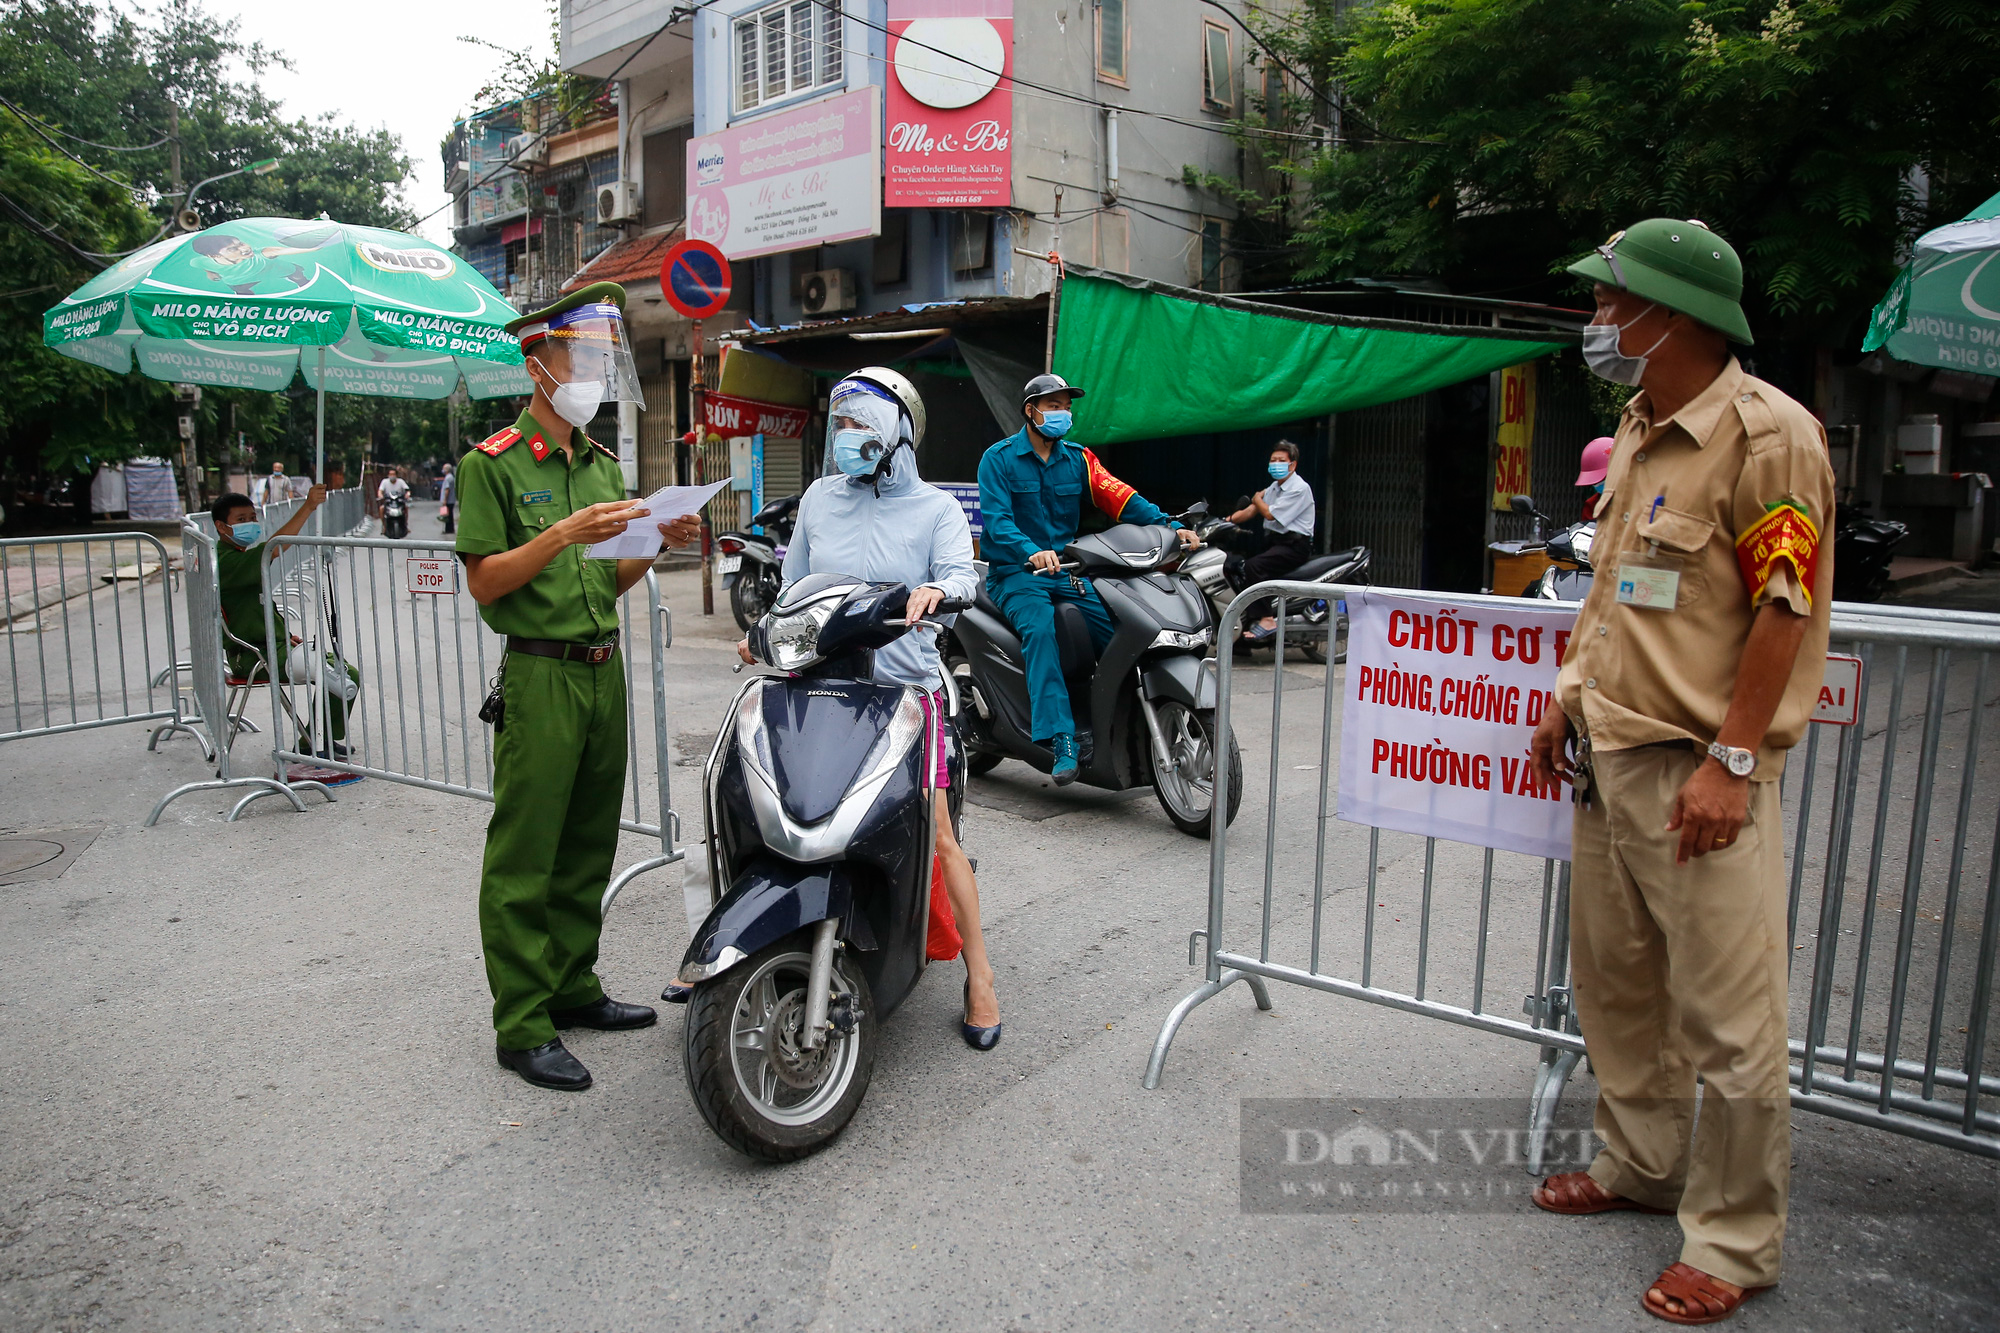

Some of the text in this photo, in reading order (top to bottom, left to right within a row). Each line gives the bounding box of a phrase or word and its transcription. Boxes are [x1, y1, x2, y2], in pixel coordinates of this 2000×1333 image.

[889, 120, 1010, 156] Mẹ & Bé
[697, 154, 724, 172] Merries
[891, 164, 1004, 176] Chuyên Order Hàng Xách Tay
[750, 171, 830, 210] Mẹ & Bé
[936, 195, 954, 204] 0944
[368, 247, 446, 270] MILO
[152, 302, 332, 324] MILO NĂNG LƯỢNG
[193, 328, 210, 336] NHÀ
[213, 320, 290, 340] VÔ ĐỊCH
[374, 310, 520, 346] MILO NĂNG LƯỢNG
[408, 330, 424, 338] CHO
[425, 333, 488, 354] VÔ ĐỊCH
[705, 401, 740, 430] BÚN
[1752, 538, 1768, 564] TỔ
[420, 562, 440, 570] POLICE
[417, 573, 444, 586] STOP
[1387, 608, 1478, 658] CHỐT
[1491, 624, 1544, 664] CƠ
[806, 690, 850, 698] HONDA
[1817, 686, 1846, 710] ẠI
[1371, 737, 1492, 792] PHƯỜNG
